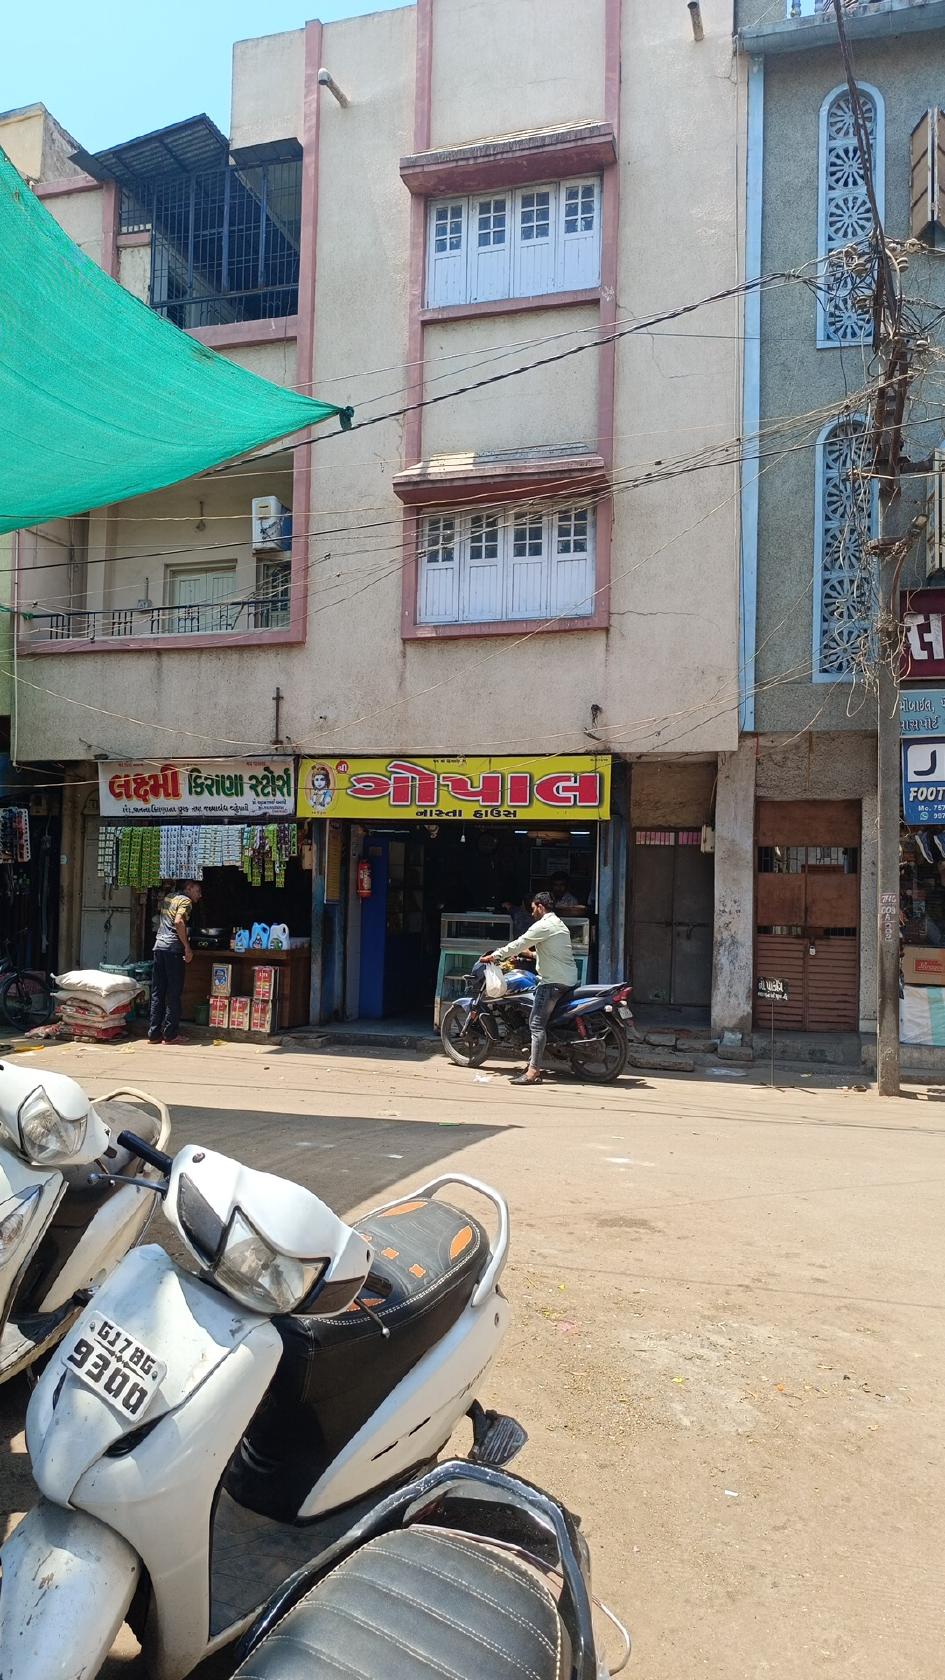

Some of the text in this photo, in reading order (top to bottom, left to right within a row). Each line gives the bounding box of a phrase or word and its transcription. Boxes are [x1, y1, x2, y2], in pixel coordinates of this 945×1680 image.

[913, 749, 937, 776] J
[108, 764, 181, 803] લક્ષ્મી
[188, 767, 244, 797] કિરાણા
[347, 760, 600, 806] ગોપાલ
[909, 786, 945, 802] FOOT
[416, 808, 517, 818] નાસ્તા હાઉસ
[67, 1338, 148, 1415] 9300
